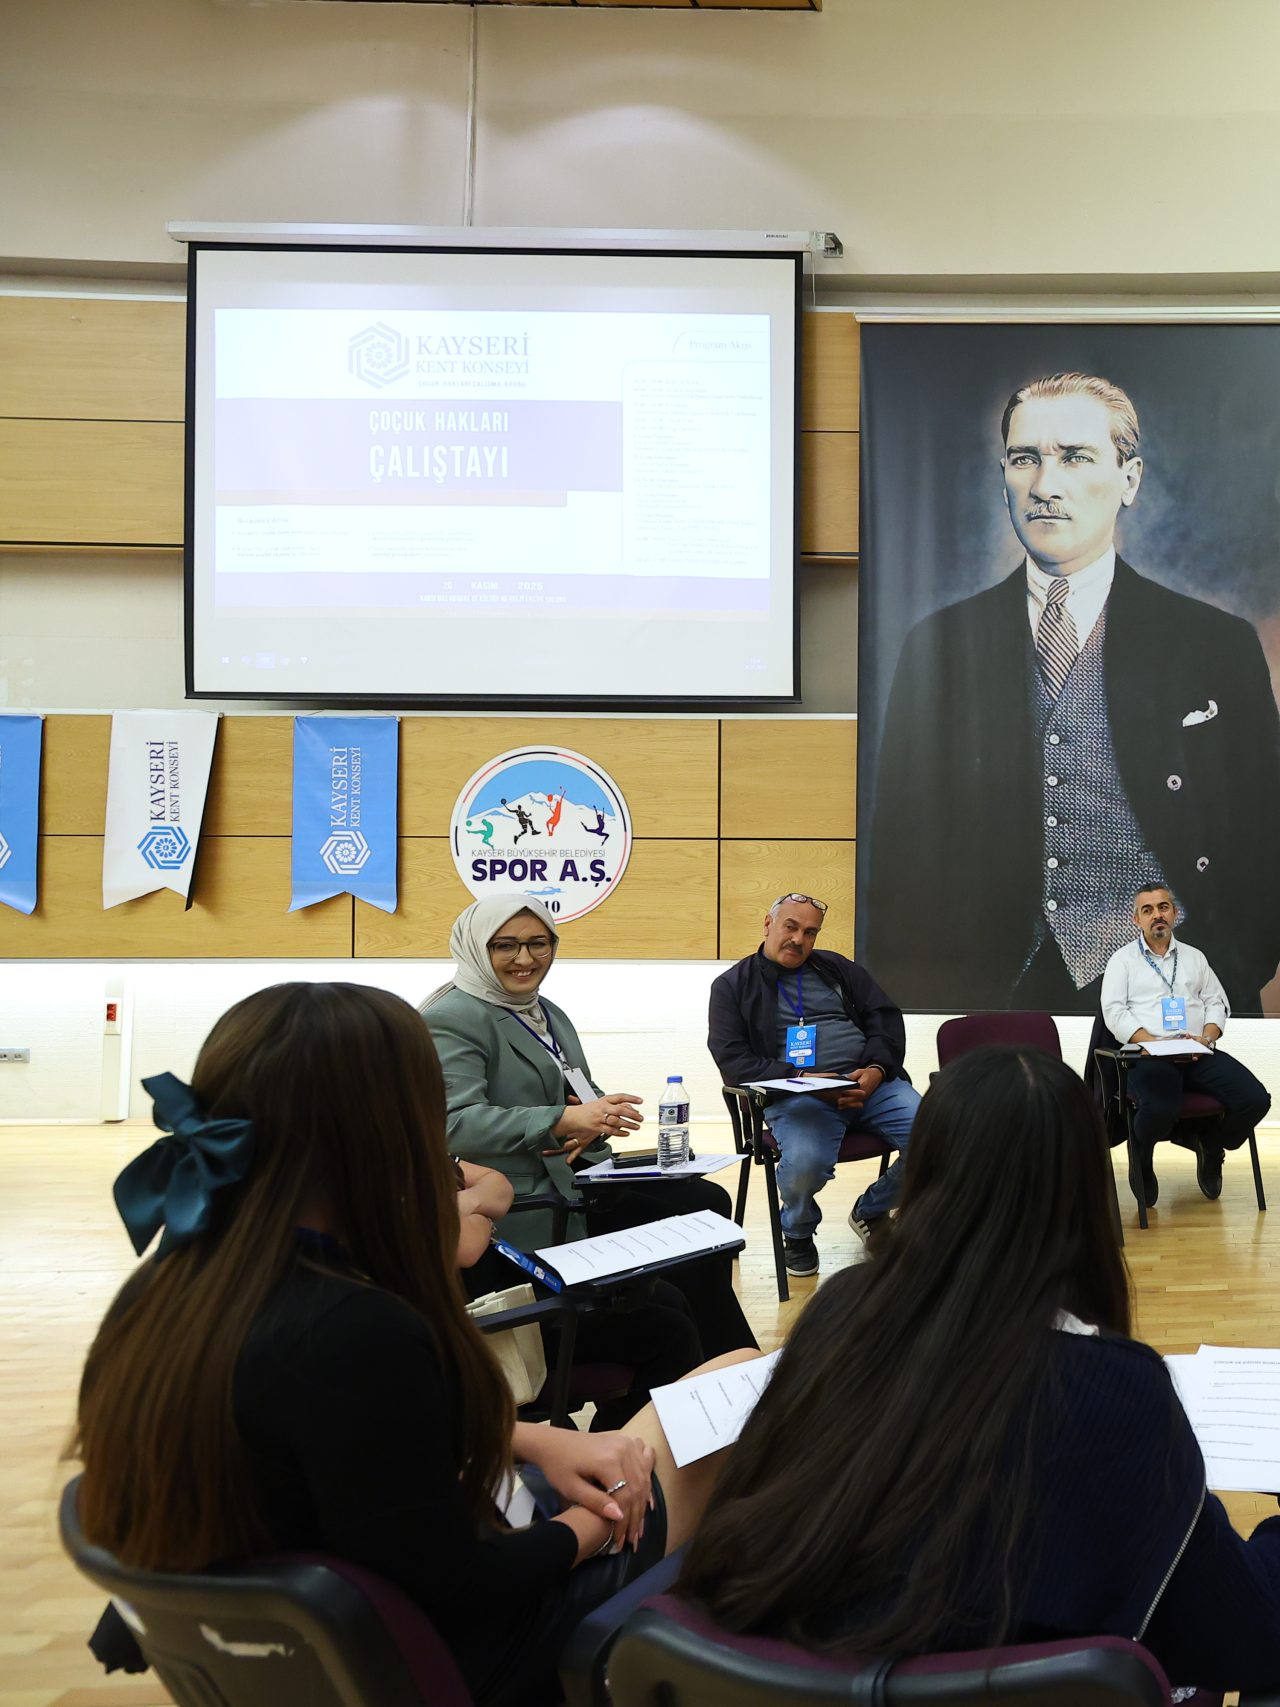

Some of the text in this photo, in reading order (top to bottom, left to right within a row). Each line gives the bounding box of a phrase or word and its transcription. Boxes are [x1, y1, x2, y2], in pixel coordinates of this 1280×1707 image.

[416, 332, 530, 356] KAYSERİ
[416, 358, 529, 375] KENT KONSEYİ
[435, 411, 509, 433] HAKLARI
[369, 444, 509, 484] ÇALIŞTAYI
[145, 740, 165, 822] KAYSERİ
[166, 741, 180, 822] KENT KONSEYİ
[329, 745, 348, 827] KAYSERİ
[348, 746, 361, 828] KENT KONSEYİ
[471, 848, 606, 858] KAYSERİ BÜYÜKŞEHİR BELEDİYESİ
[471, 858, 612, 888] SPOR A.Ş.
